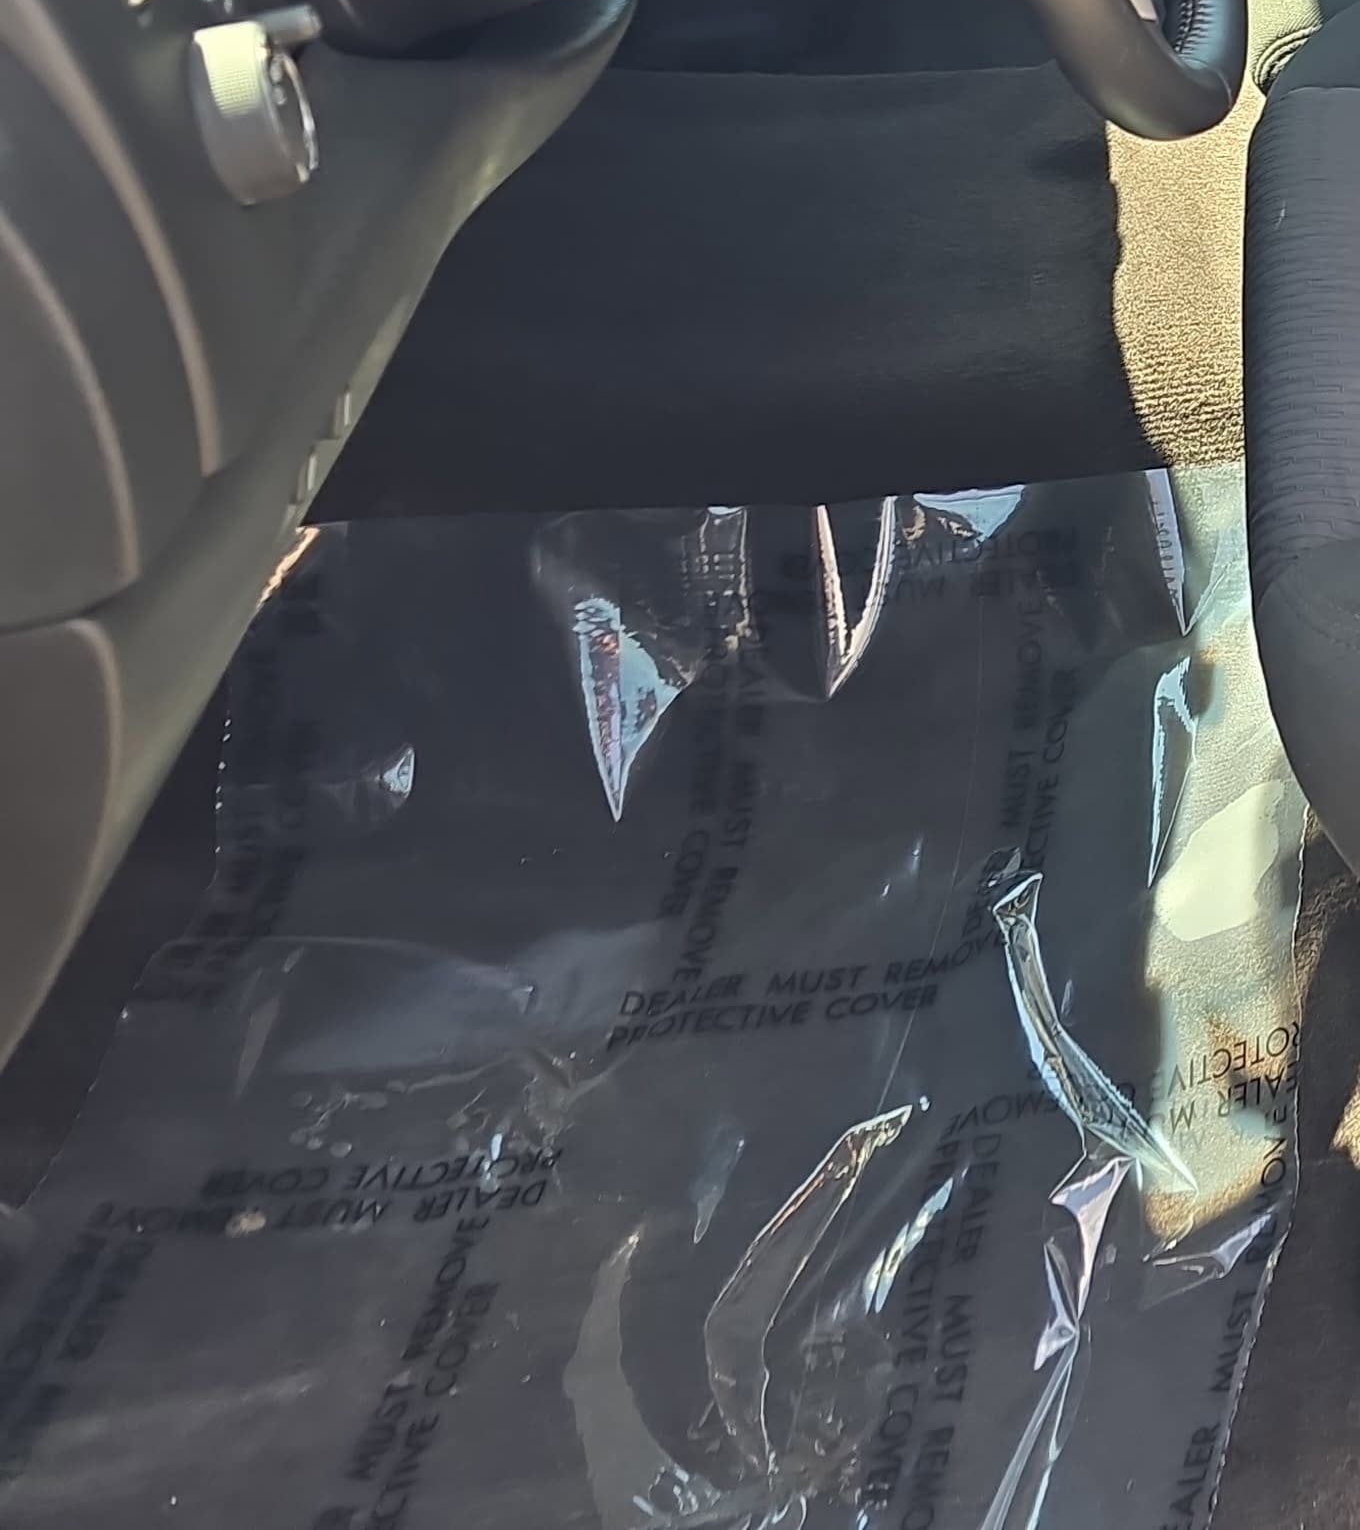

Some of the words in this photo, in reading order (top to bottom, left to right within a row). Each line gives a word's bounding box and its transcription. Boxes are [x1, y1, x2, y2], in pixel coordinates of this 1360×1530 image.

[605, 996, 808, 1053] PROTECTIVE
[824, 982, 941, 1022] COVER
[617, 974, 744, 1018] DEALER
[766, 961, 867, 996] MUST
[412, 1179, 549, 1223] DEALER
[935, 1294, 973, 1403] MUST
[1209, 1289, 1257, 1394] MUST
